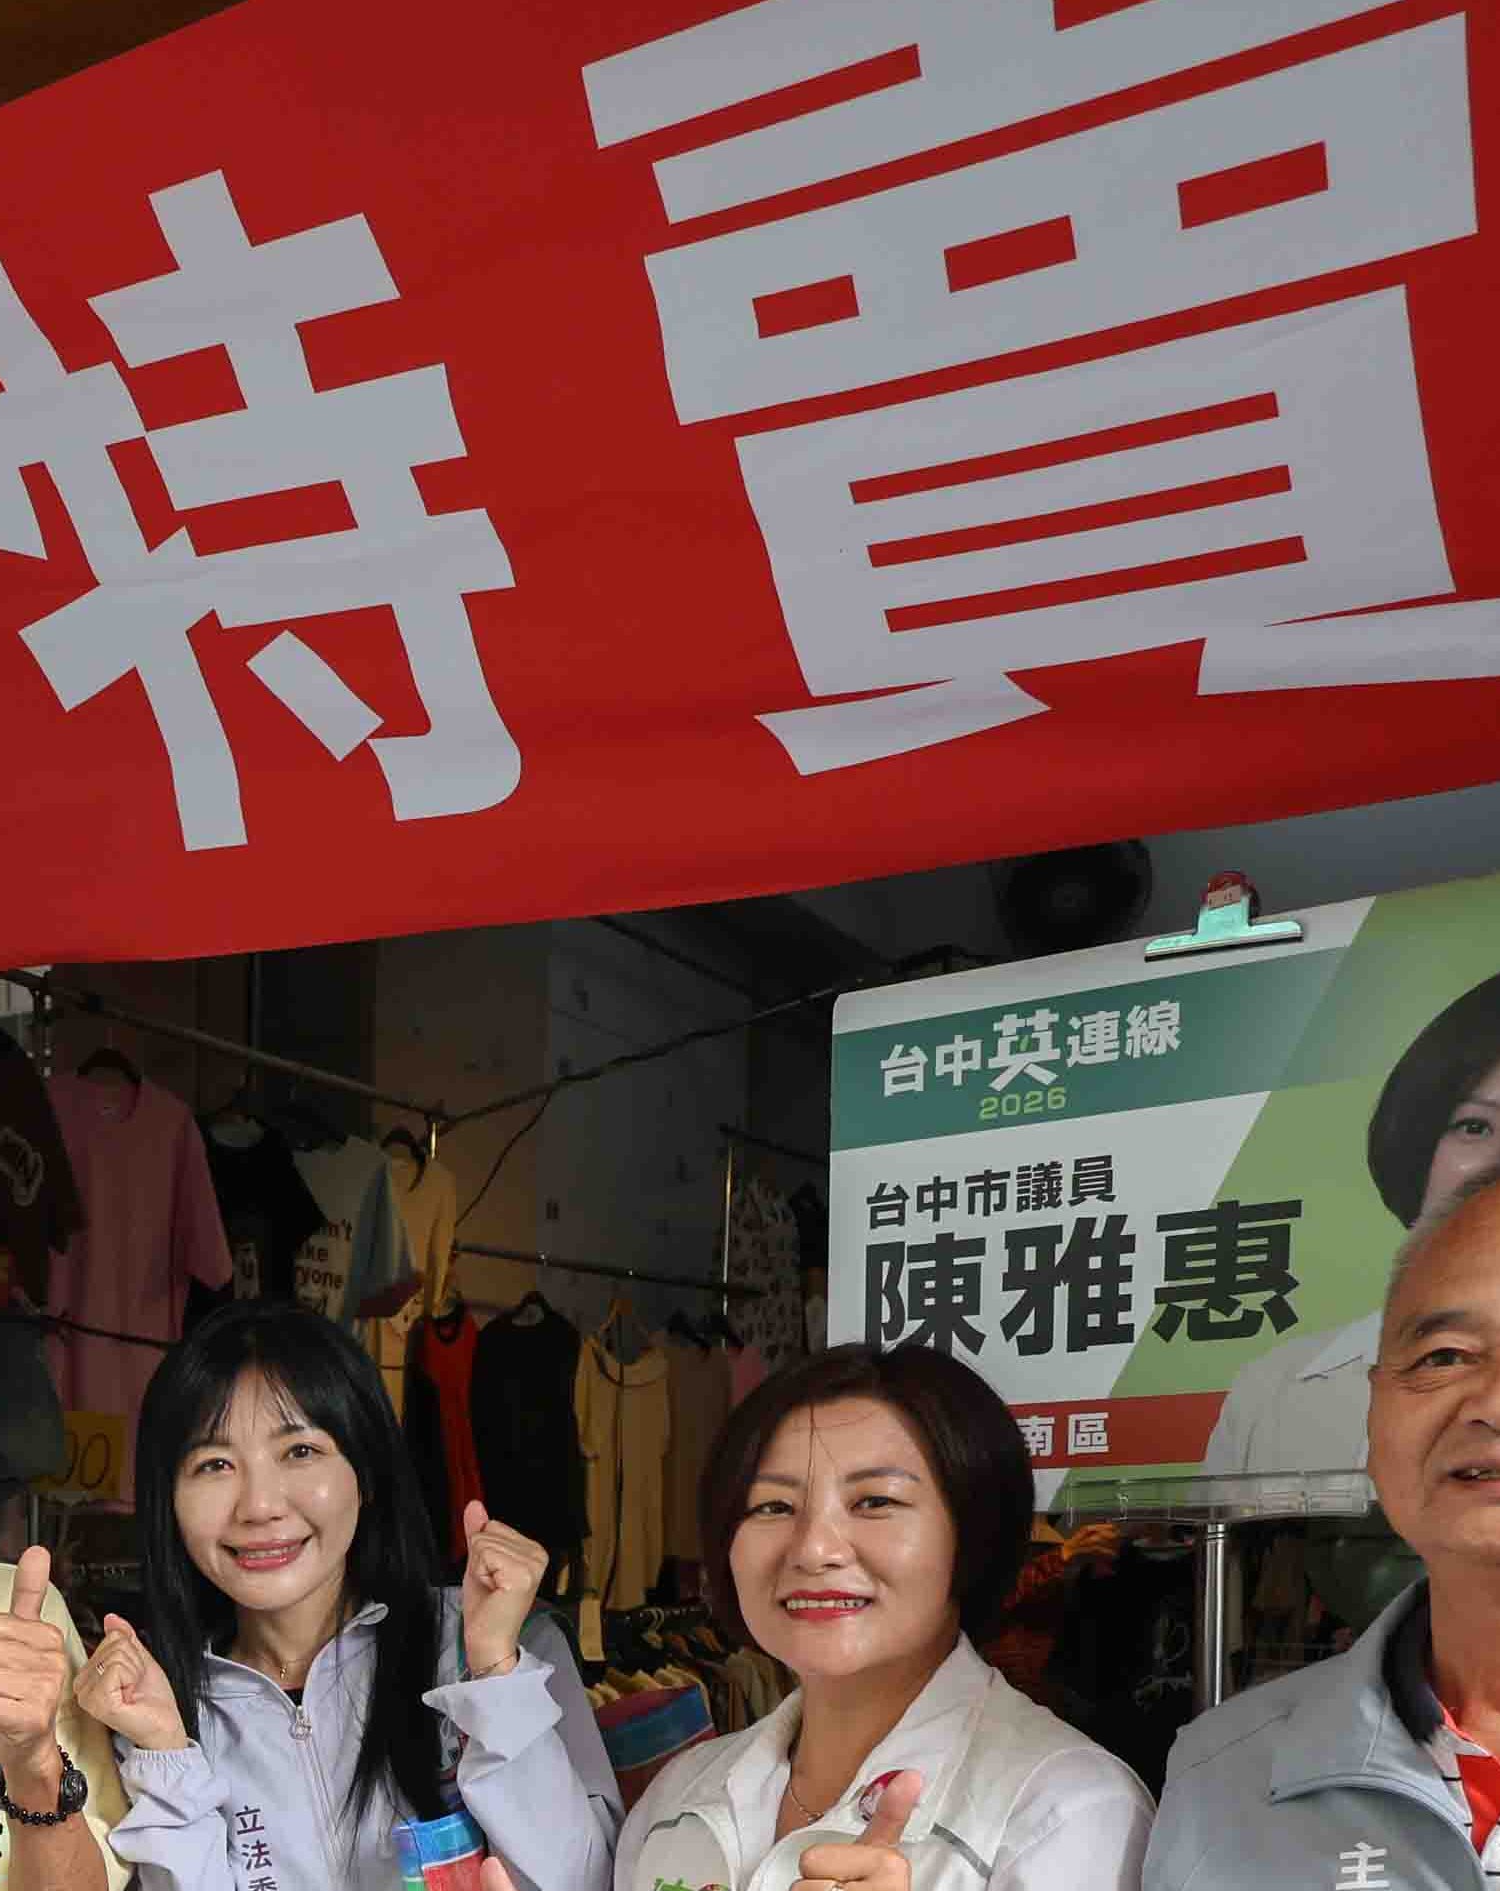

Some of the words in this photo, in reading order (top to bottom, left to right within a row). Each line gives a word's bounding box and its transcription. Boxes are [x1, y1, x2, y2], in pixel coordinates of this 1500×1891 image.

[880, 1000, 1182, 1098] 台中英連線
[978, 1086, 1067, 1121] 2026
[865, 1154, 1117, 1231] 台中市議員
[865, 1197, 1303, 1358] 陳雅惠
